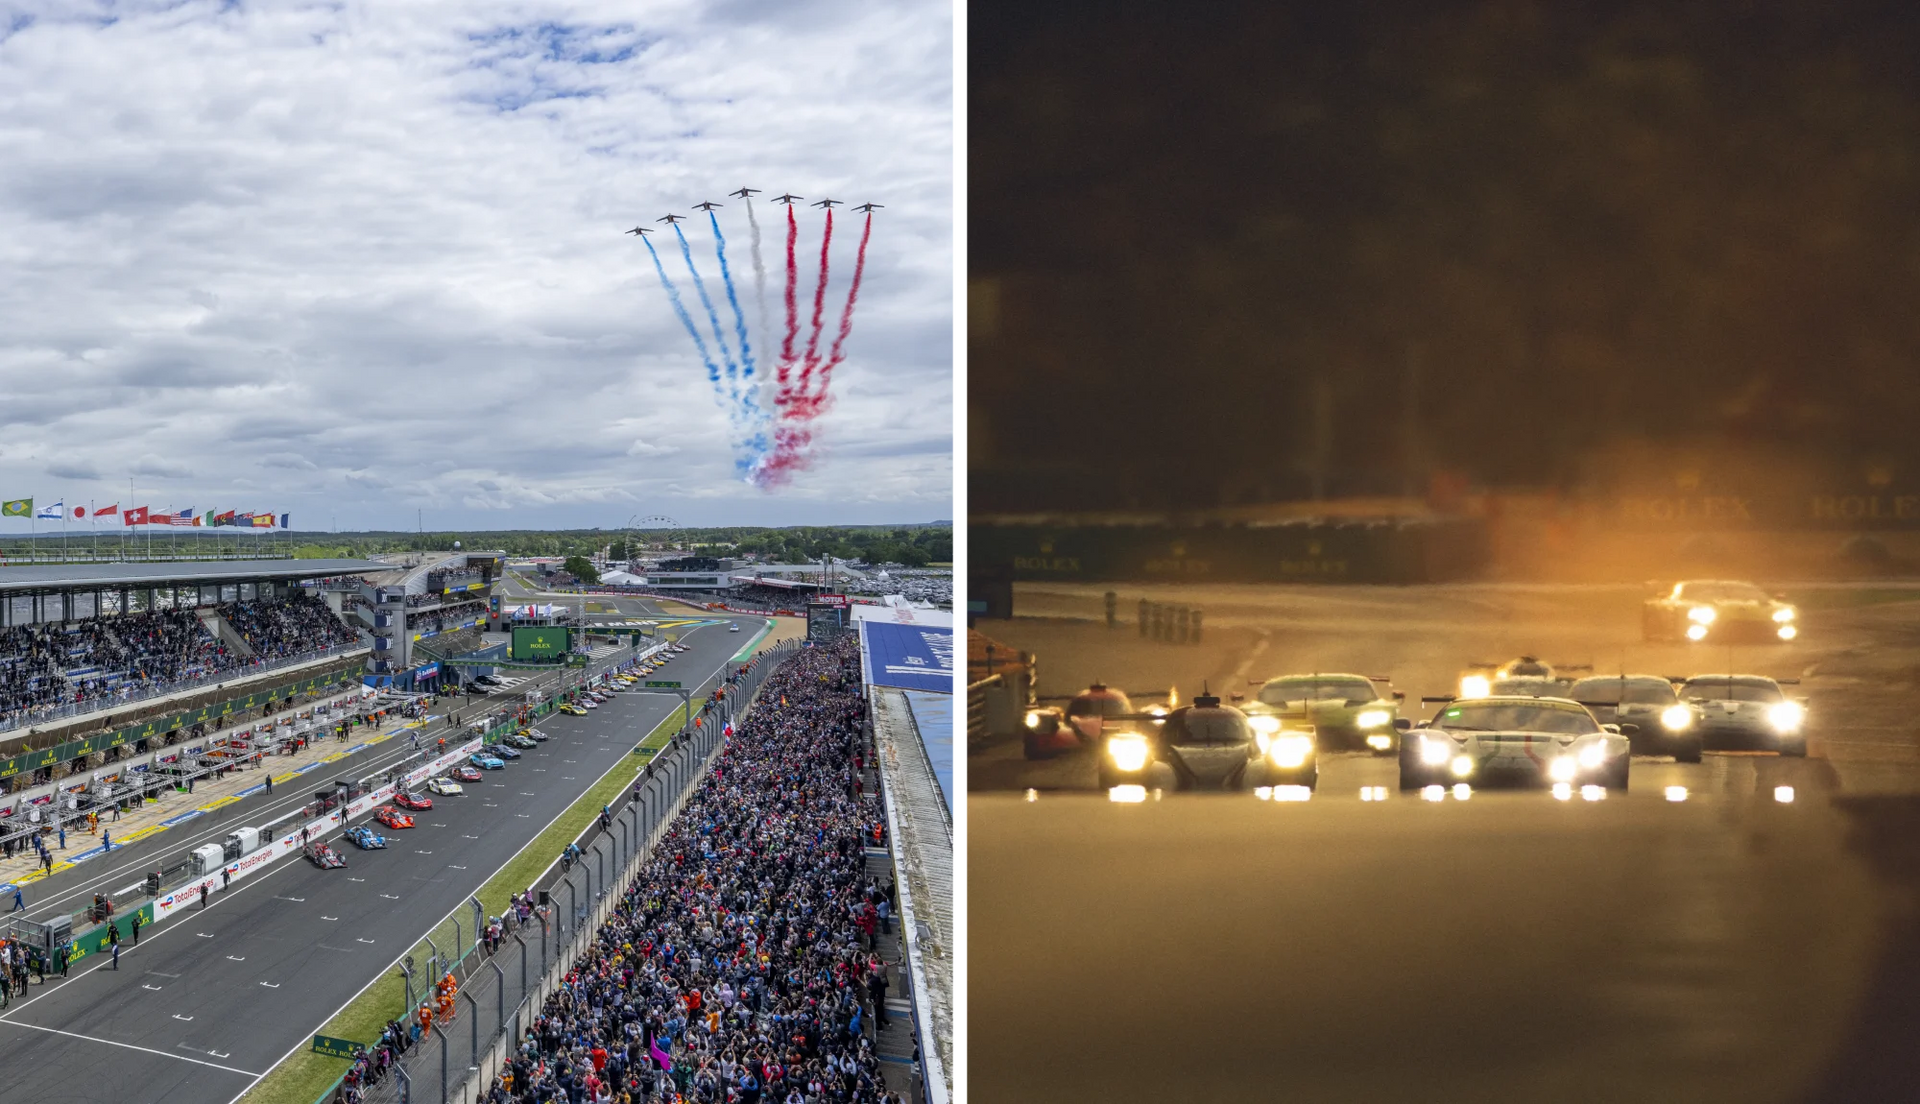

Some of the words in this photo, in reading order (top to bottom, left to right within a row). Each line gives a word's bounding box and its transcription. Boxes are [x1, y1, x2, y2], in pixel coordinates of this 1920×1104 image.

[1014, 556, 1080, 572] ROLEX
[111, 738, 126, 746] ROLEX
[77, 747, 93, 755] ROLEX
[41, 757, 57, 766] ROLEX
[1, 767, 19, 777] ROLEX
[239, 849, 273, 872] TotalEnergies
[68, 949, 86, 963] OLEX
[315, 1045, 337, 1056] ROLEX
